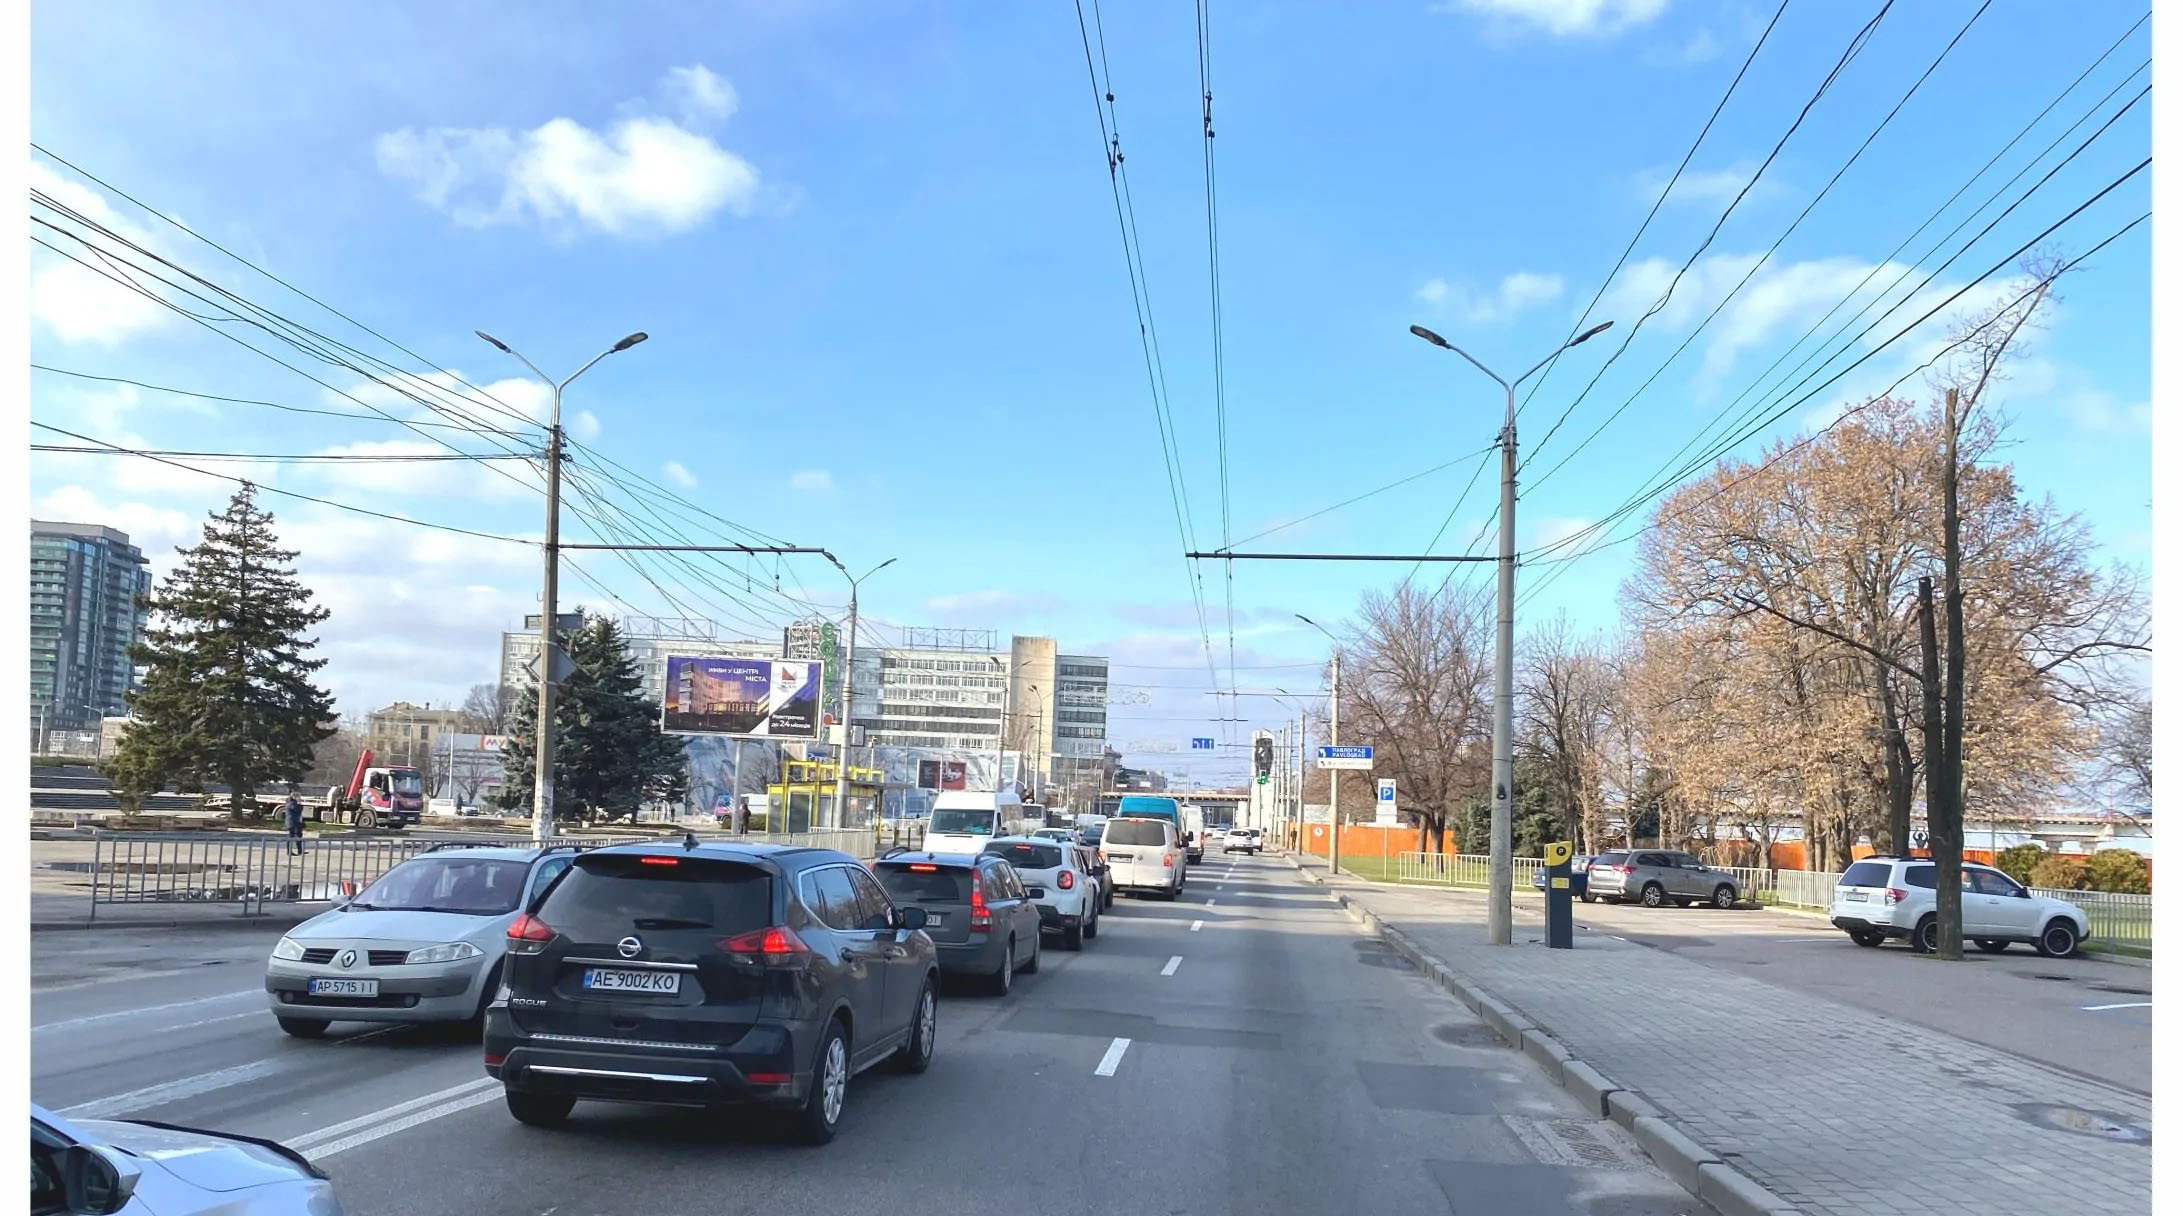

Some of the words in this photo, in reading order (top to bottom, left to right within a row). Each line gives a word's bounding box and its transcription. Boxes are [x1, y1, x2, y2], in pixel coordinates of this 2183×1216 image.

[1383, 788, 1391, 799] P
[318, 981, 331, 992] AP
[333, 982, 357, 992] 5715
[592, 972, 613, 986] AE
[617, 973, 649, 988] 9002
[652, 974, 674, 990] KO
[512, 998, 548, 1006] ROGUE
